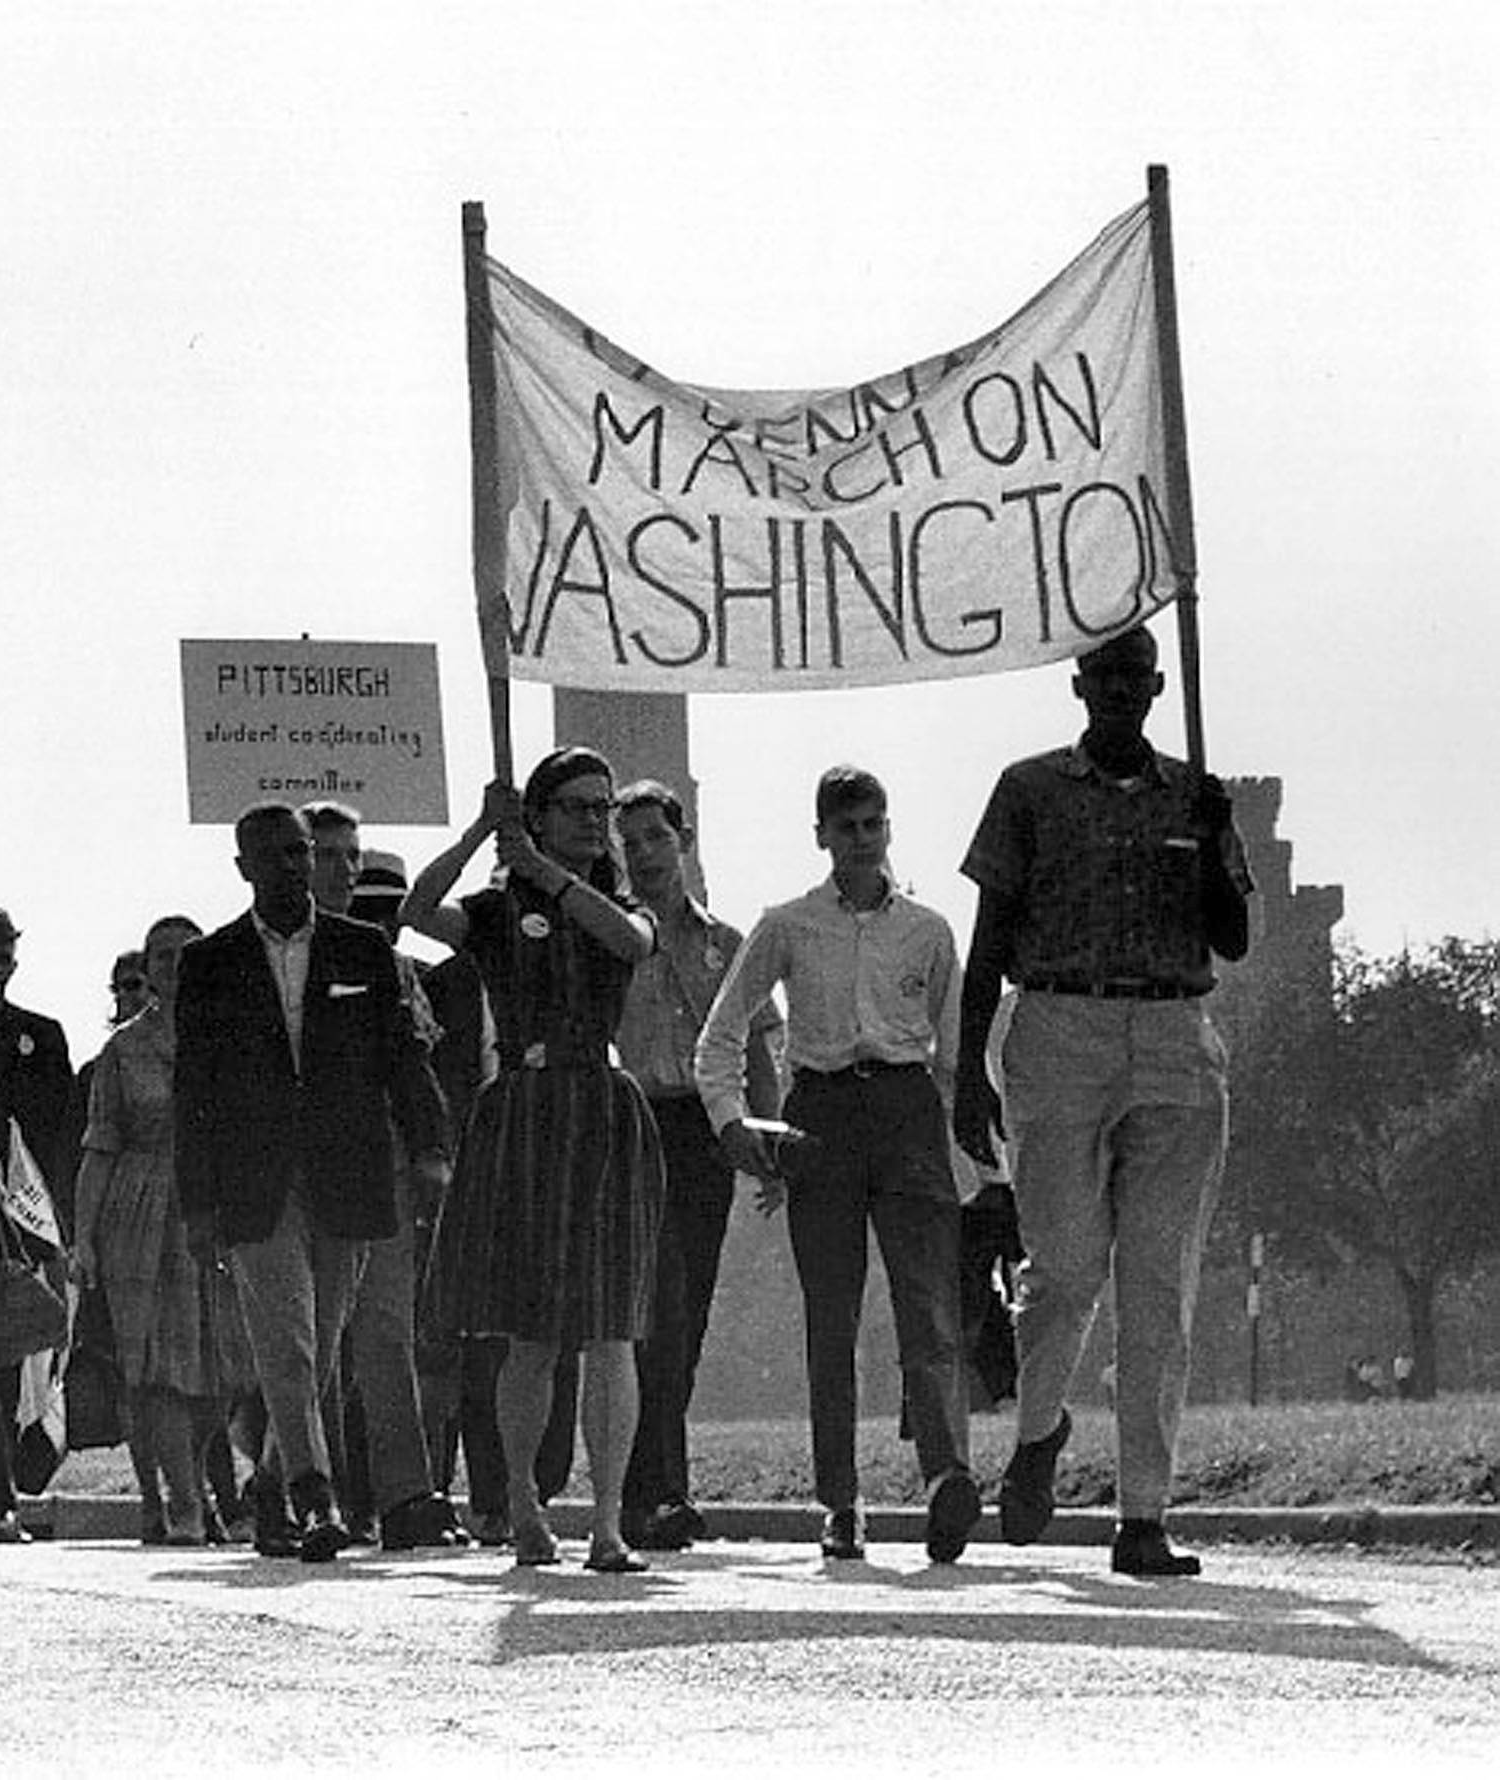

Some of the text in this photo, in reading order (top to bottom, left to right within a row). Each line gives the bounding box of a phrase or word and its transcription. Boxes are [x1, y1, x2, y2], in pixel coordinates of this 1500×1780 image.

[589, 352, 1102, 511] MARCH ON
[217, 664, 390, 698] PITTSBURGH
[204, 722, 278, 743] student
[257, 769, 367, 793] committee
